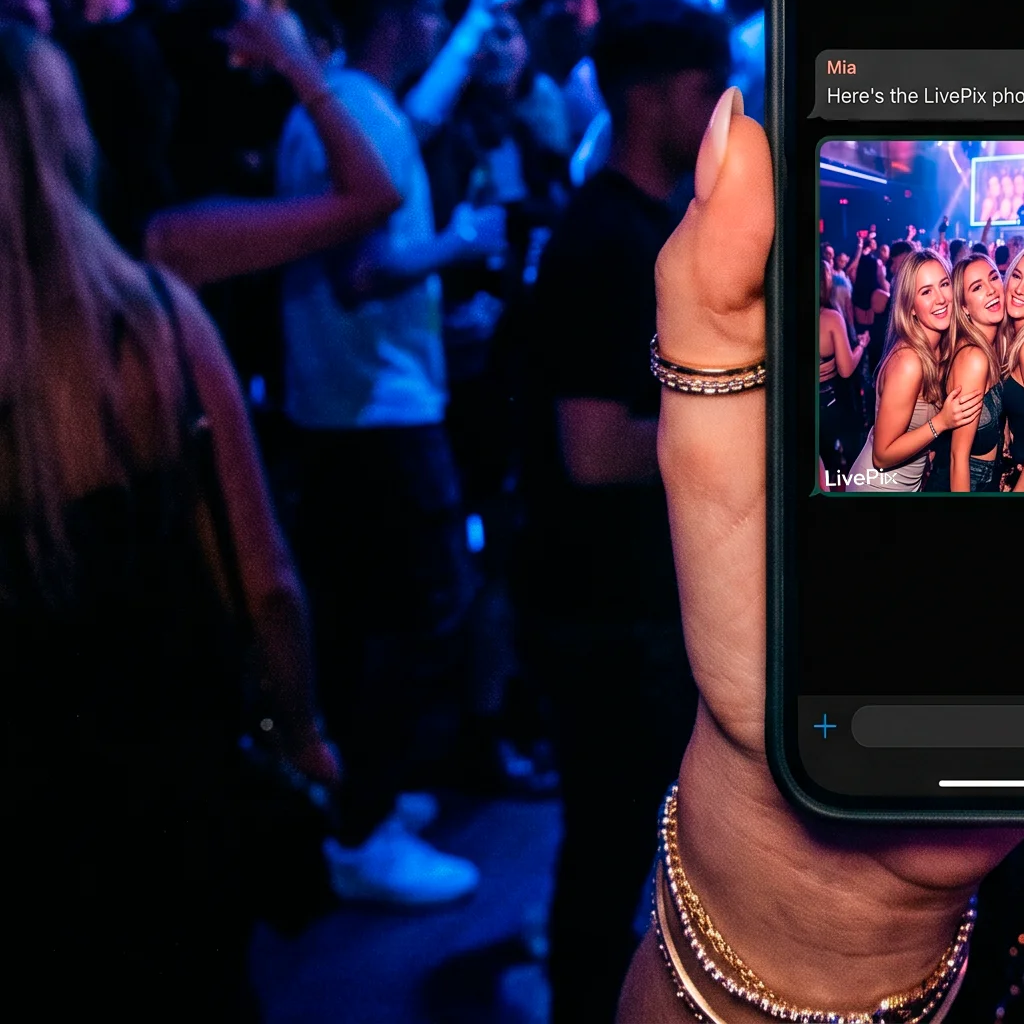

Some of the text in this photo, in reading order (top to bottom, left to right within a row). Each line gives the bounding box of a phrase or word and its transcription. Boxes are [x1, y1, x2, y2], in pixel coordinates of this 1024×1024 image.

[827, 59, 857, 75] Mia
[827, 87, 885, 104] Here's
[889, 86, 919, 104] the
[924, 86, 987, 104] LivePix
[824, 467, 899, 487] LivePix
